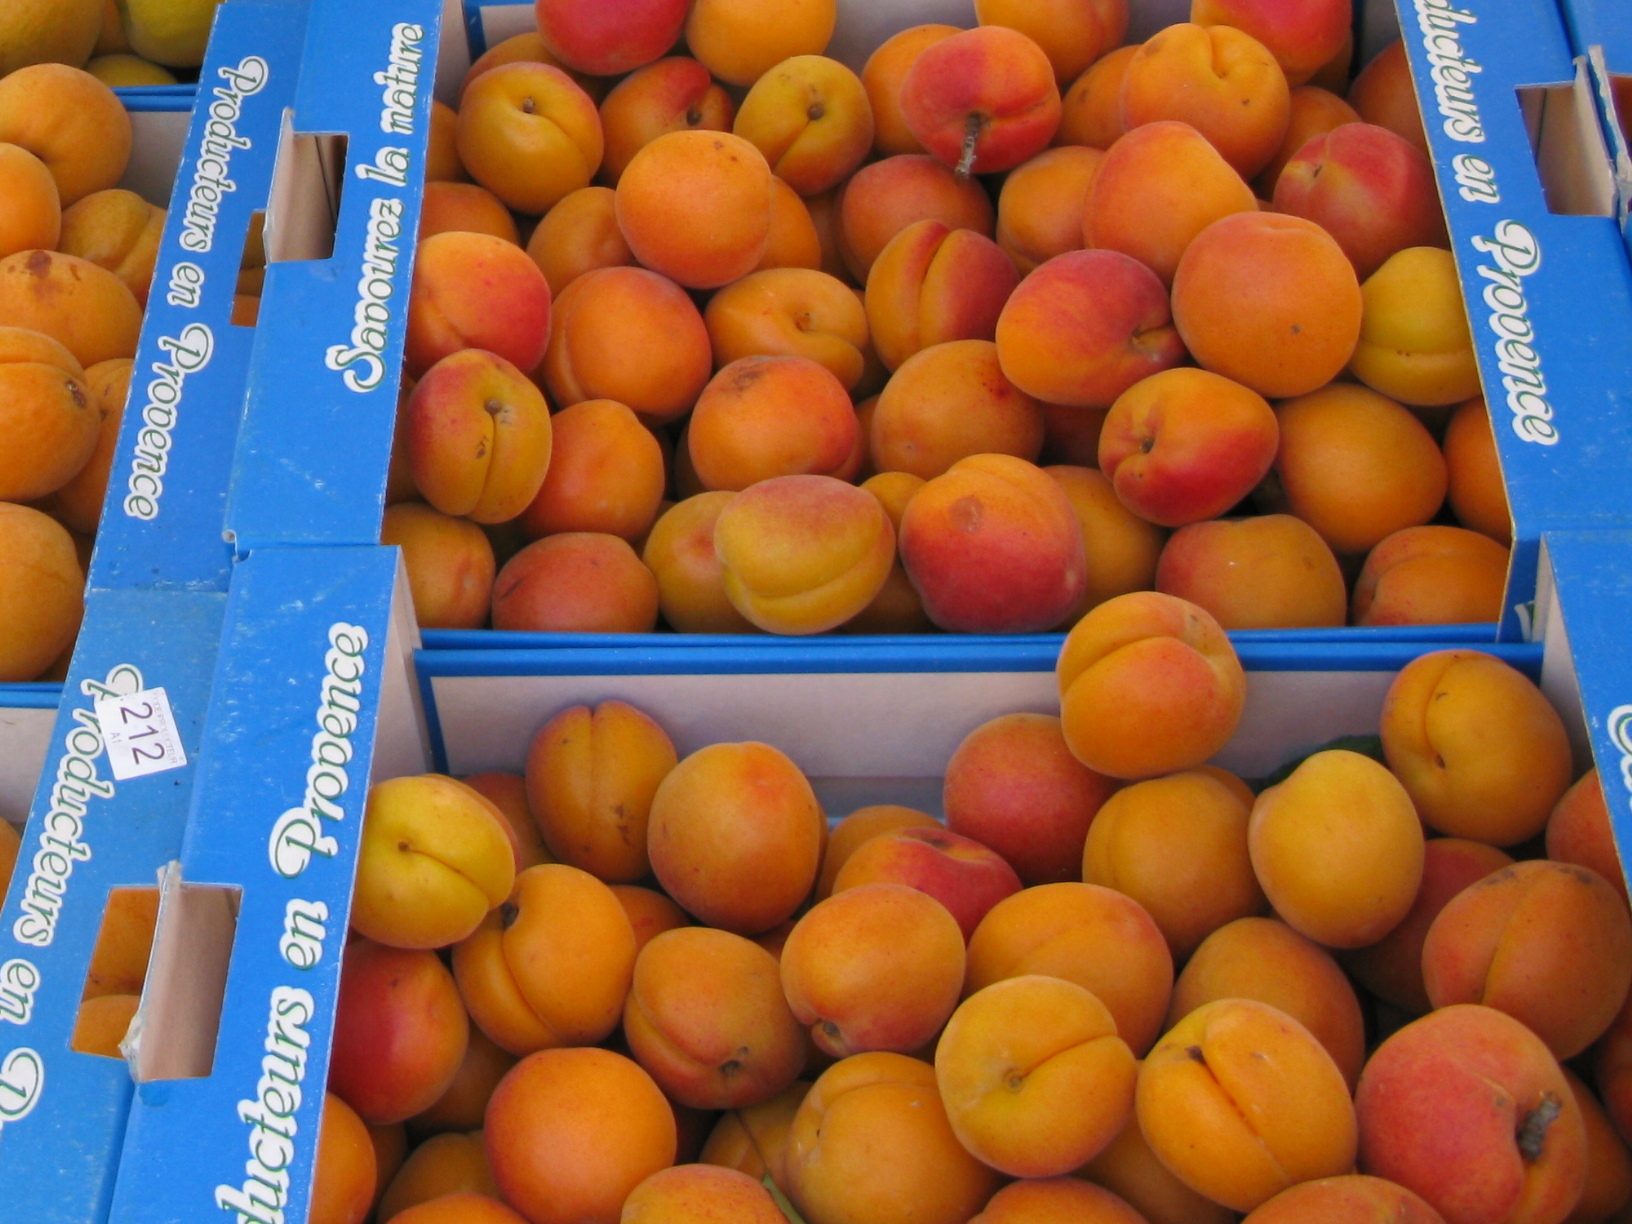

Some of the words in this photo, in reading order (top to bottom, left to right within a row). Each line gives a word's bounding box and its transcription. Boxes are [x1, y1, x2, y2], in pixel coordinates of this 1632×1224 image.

[373, 22, 425, 134] nature
[179, 56, 269, 253] Producteurs
[355, 146, 410, 188] la
[1451, 152, 1500, 204] en
[167, 261, 205, 309] en
[325, 197, 407, 393] Savourez
[1471, 218, 1559, 445] Provence
[123, 323, 214, 521] Provence
[120, 701, 165, 765] 212
[270, 622, 368, 880] Provence
[279, 898, 329, 971] en
